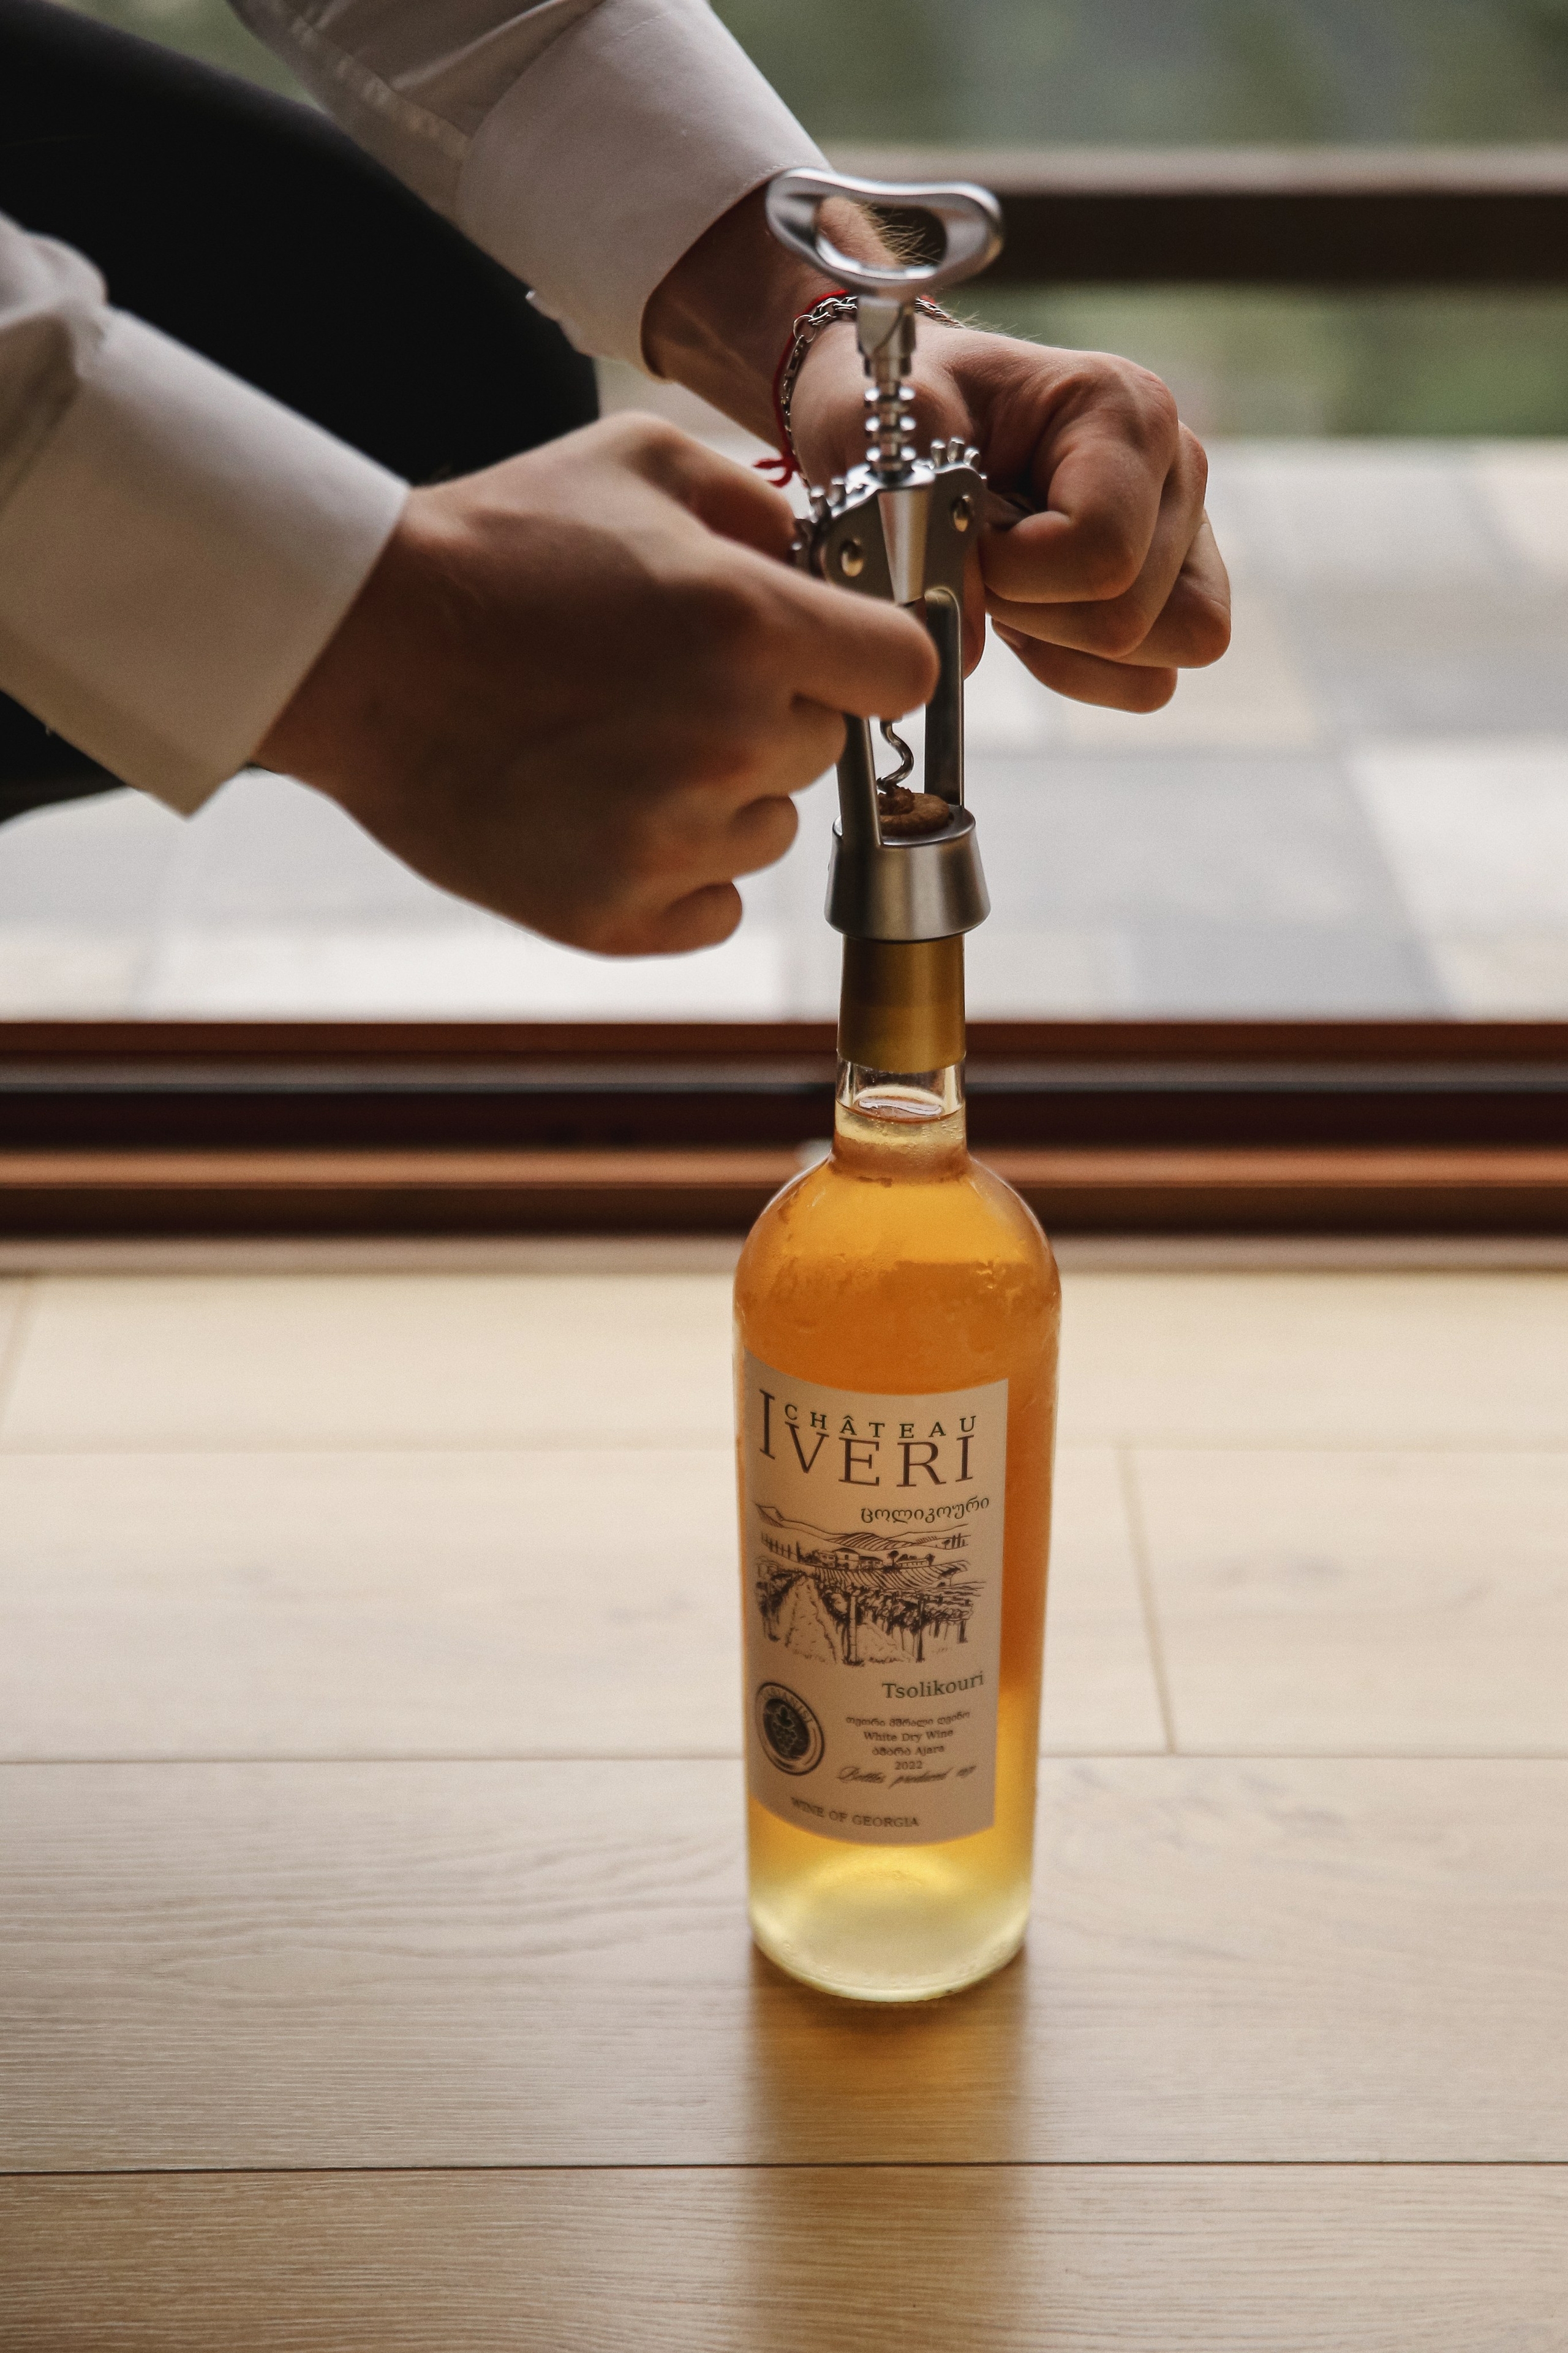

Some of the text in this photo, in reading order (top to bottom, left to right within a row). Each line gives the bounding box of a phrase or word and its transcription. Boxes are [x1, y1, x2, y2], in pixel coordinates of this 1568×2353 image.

[784, 1403, 976, 1438] CHÂTEAU
[760, 1389, 974, 1487] IVERI
[861, 1495, 989, 1524] ცოლიკოური
[882, 1671, 984, 1699] Tsolikouri
[864, 1730, 953, 1743] White Dry Wine
[894, 1760, 923, 1770] 2022
[791, 1797, 919, 1827] WINE OF GEORGIA
